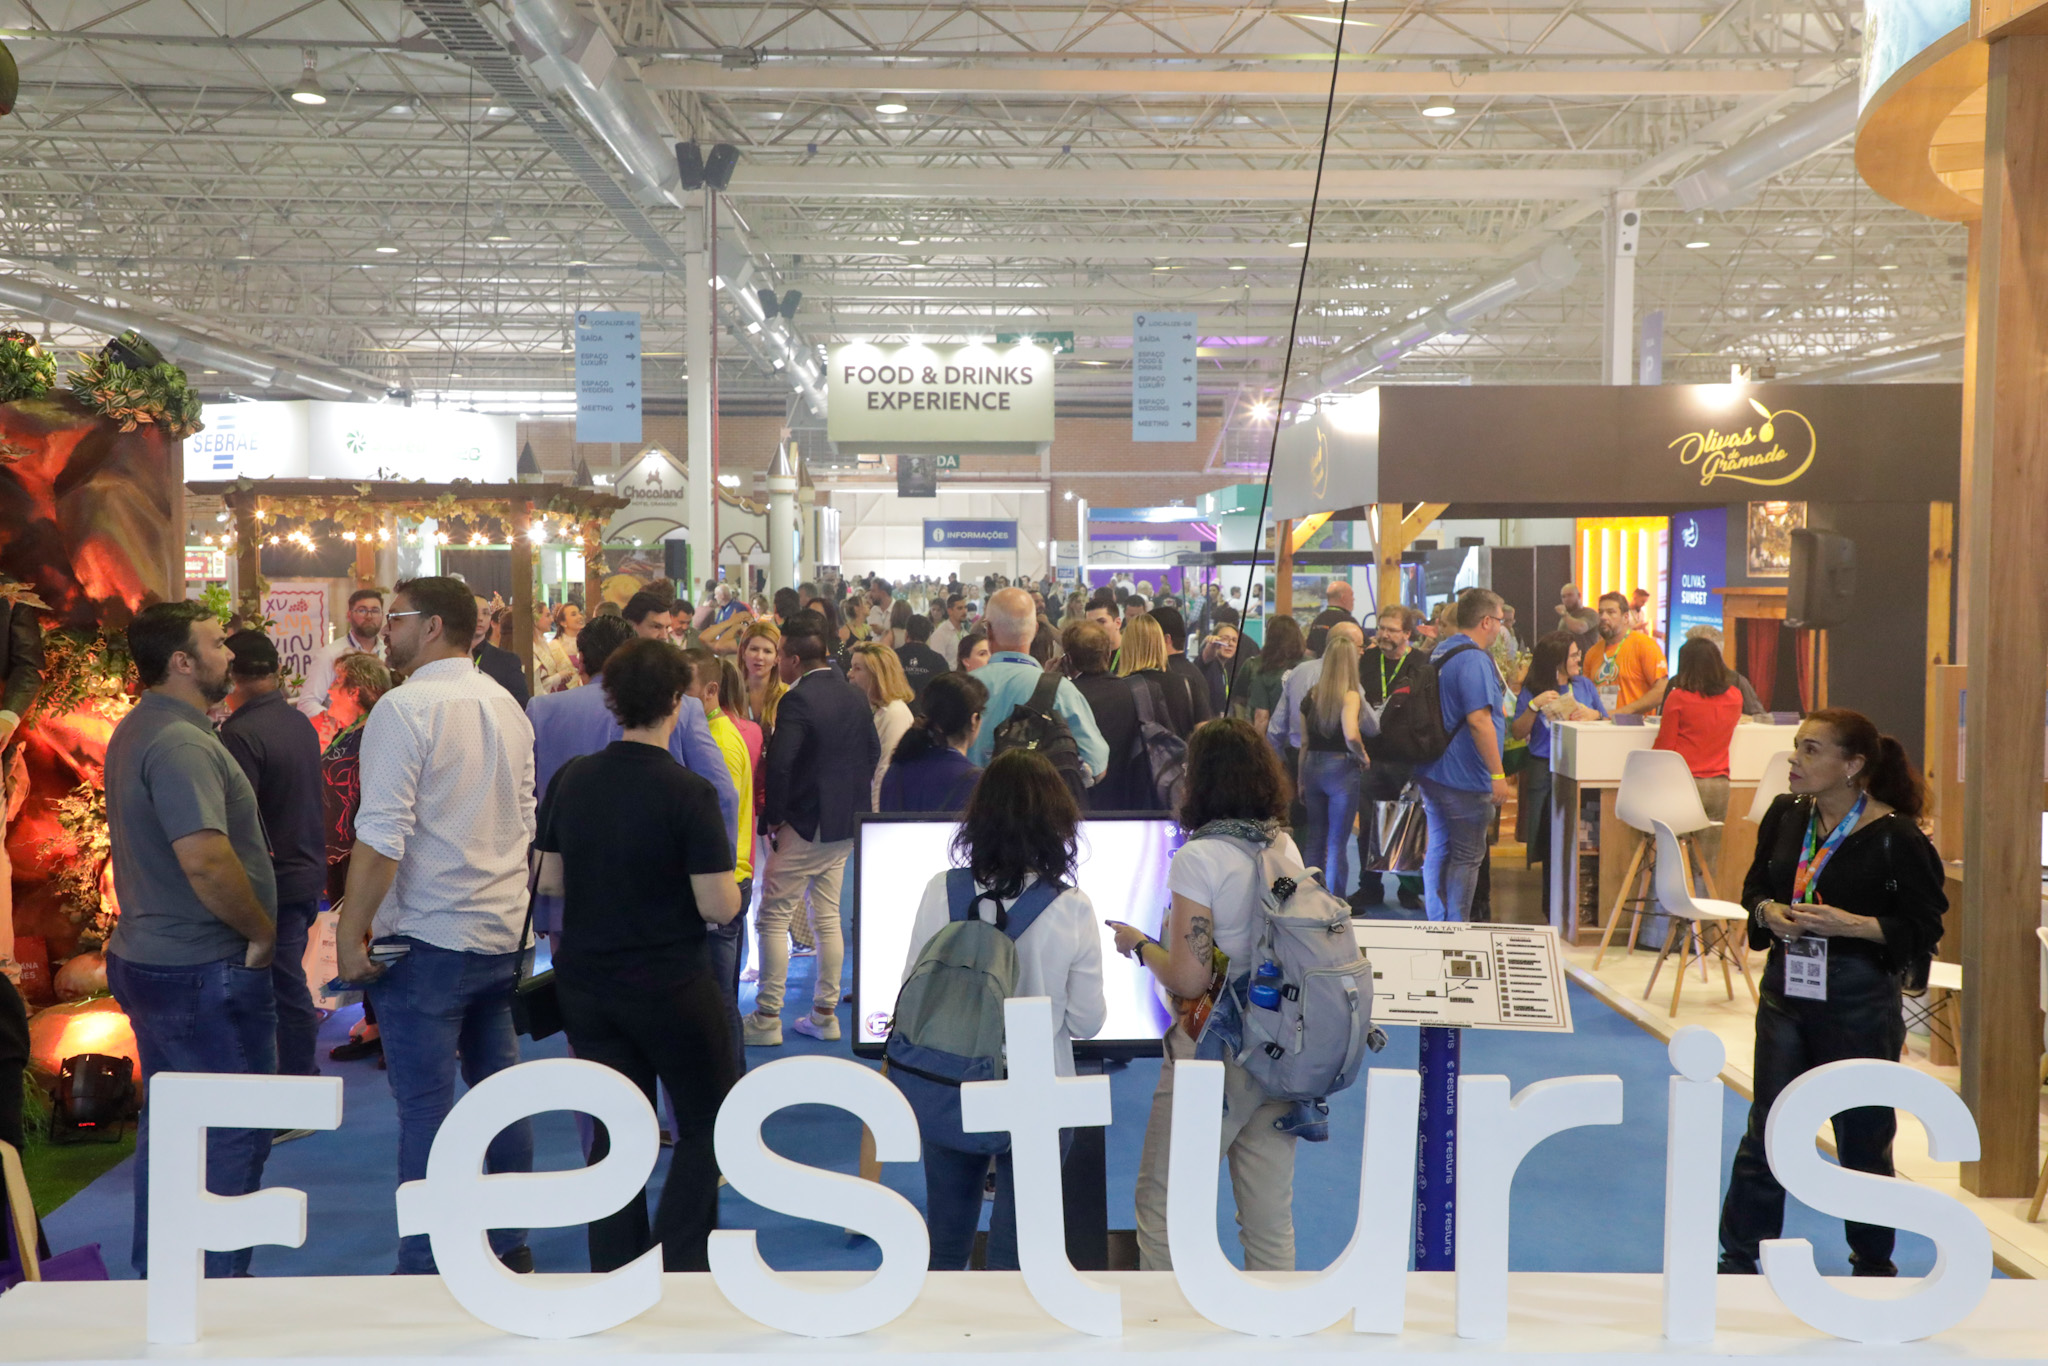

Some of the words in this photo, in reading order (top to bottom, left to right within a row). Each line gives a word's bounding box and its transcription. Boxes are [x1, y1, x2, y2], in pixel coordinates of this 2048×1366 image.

[580, 333, 603, 342] SAÍDA
[580, 352, 609, 361] ESPAÇO
[1138, 351, 1166, 359] ESPAÇO
[844, 366, 914, 385] FOOD
[921, 366, 938, 385] &
[944, 366, 1033, 385] DRINKS
[1138, 376, 1166, 384] ESPAÇO
[581, 380, 610, 388] ESPAÇO
[581, 404, 614, 412] MEETING
[867, 391, 1011, 410] EXPERIENCE
[192, 431, 260, 453] SEBRAE
[1668, 426, 1757, 465] Olivas
[1700, 443, 1789, 486] Gramado
[623, 485, 685, 499] Chocoland
[947, 530, 1009, 541] INFORMAÇÕES
[1681, 574, 1707, 588] OLIVAS
[1681, 590, 1707, 605] SUNSET
[1446, 1071, 1455, 1116] Festuris
[147, 994, 1995, 1346] Festuris
[1445, 1140, 1454, 1185] Festuris
[1444, 1211, 1453, 1256] Festuris
